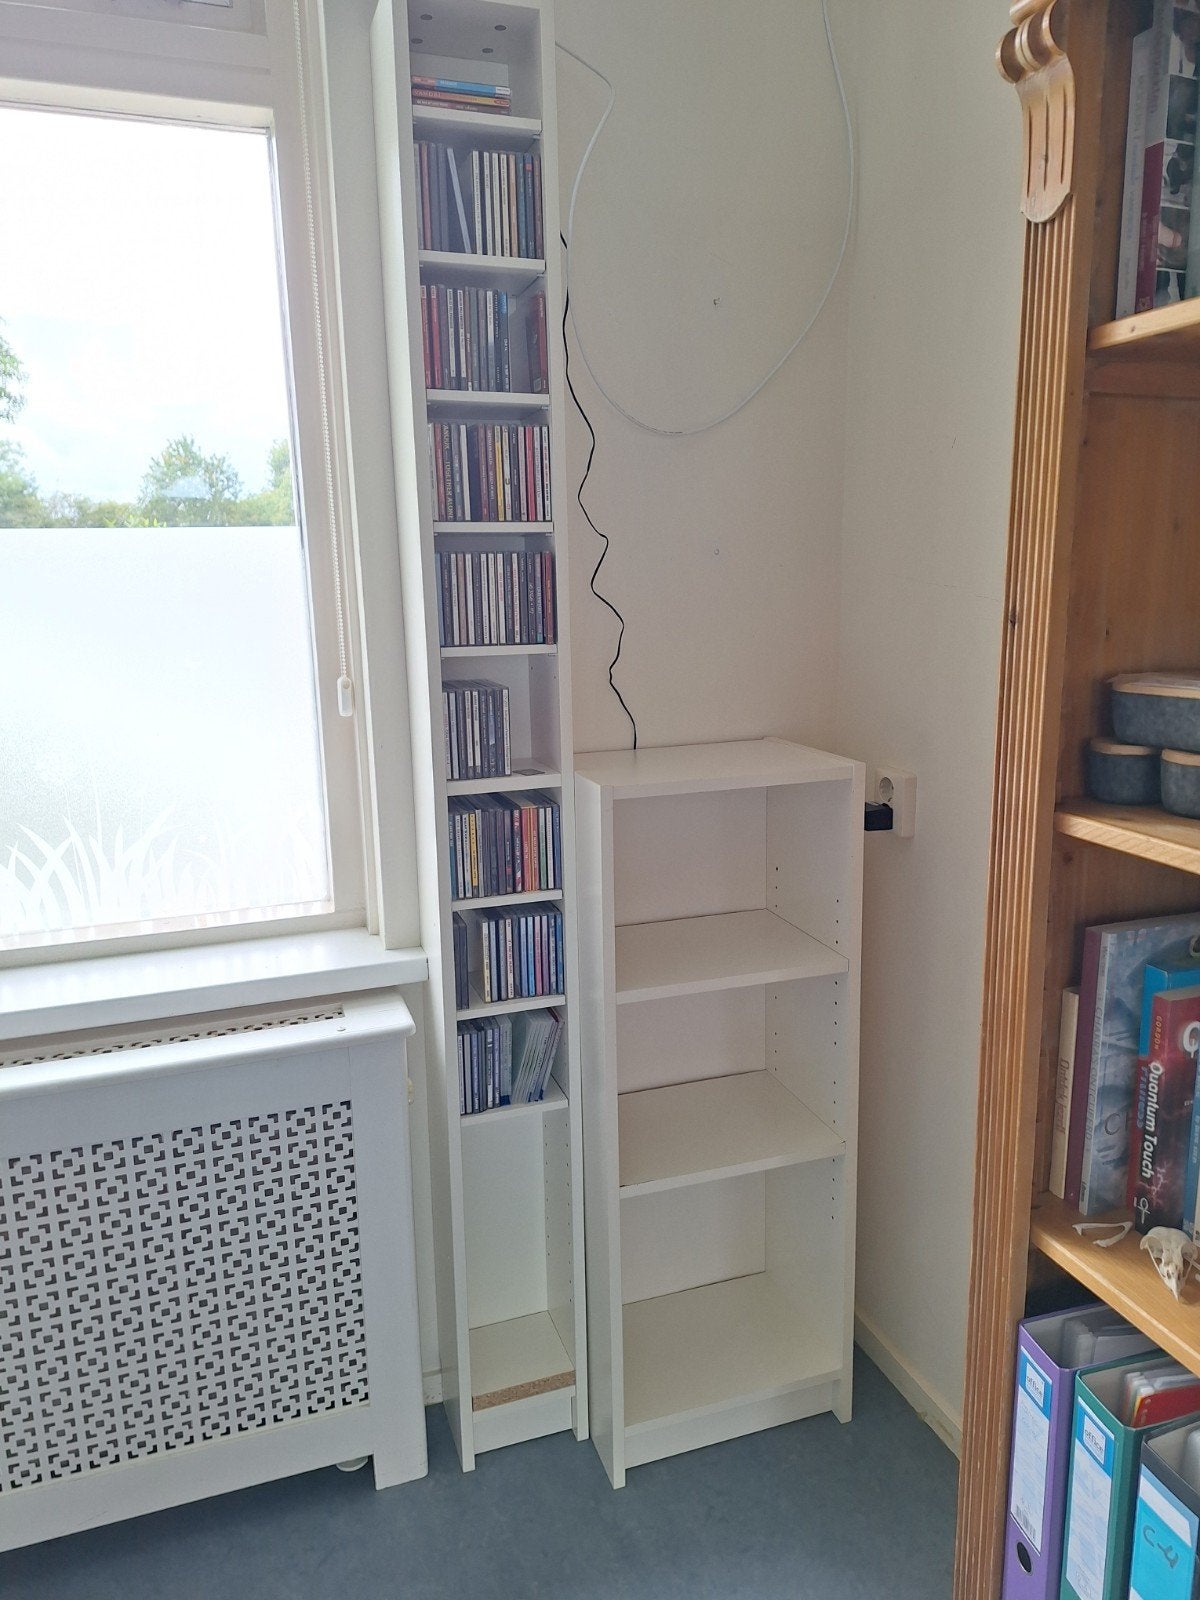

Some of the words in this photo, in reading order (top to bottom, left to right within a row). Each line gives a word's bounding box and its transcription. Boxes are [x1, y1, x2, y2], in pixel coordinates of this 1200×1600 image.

[1154, 1016, 1163, 1050] GORDON
[1143, 1061, 1164, 1133] Quantum
[1142, 1133, 1158, 1179] Touch
[1026, 1376, 1042, 1396] office
[1085, 1429, 1104, 1453] office
